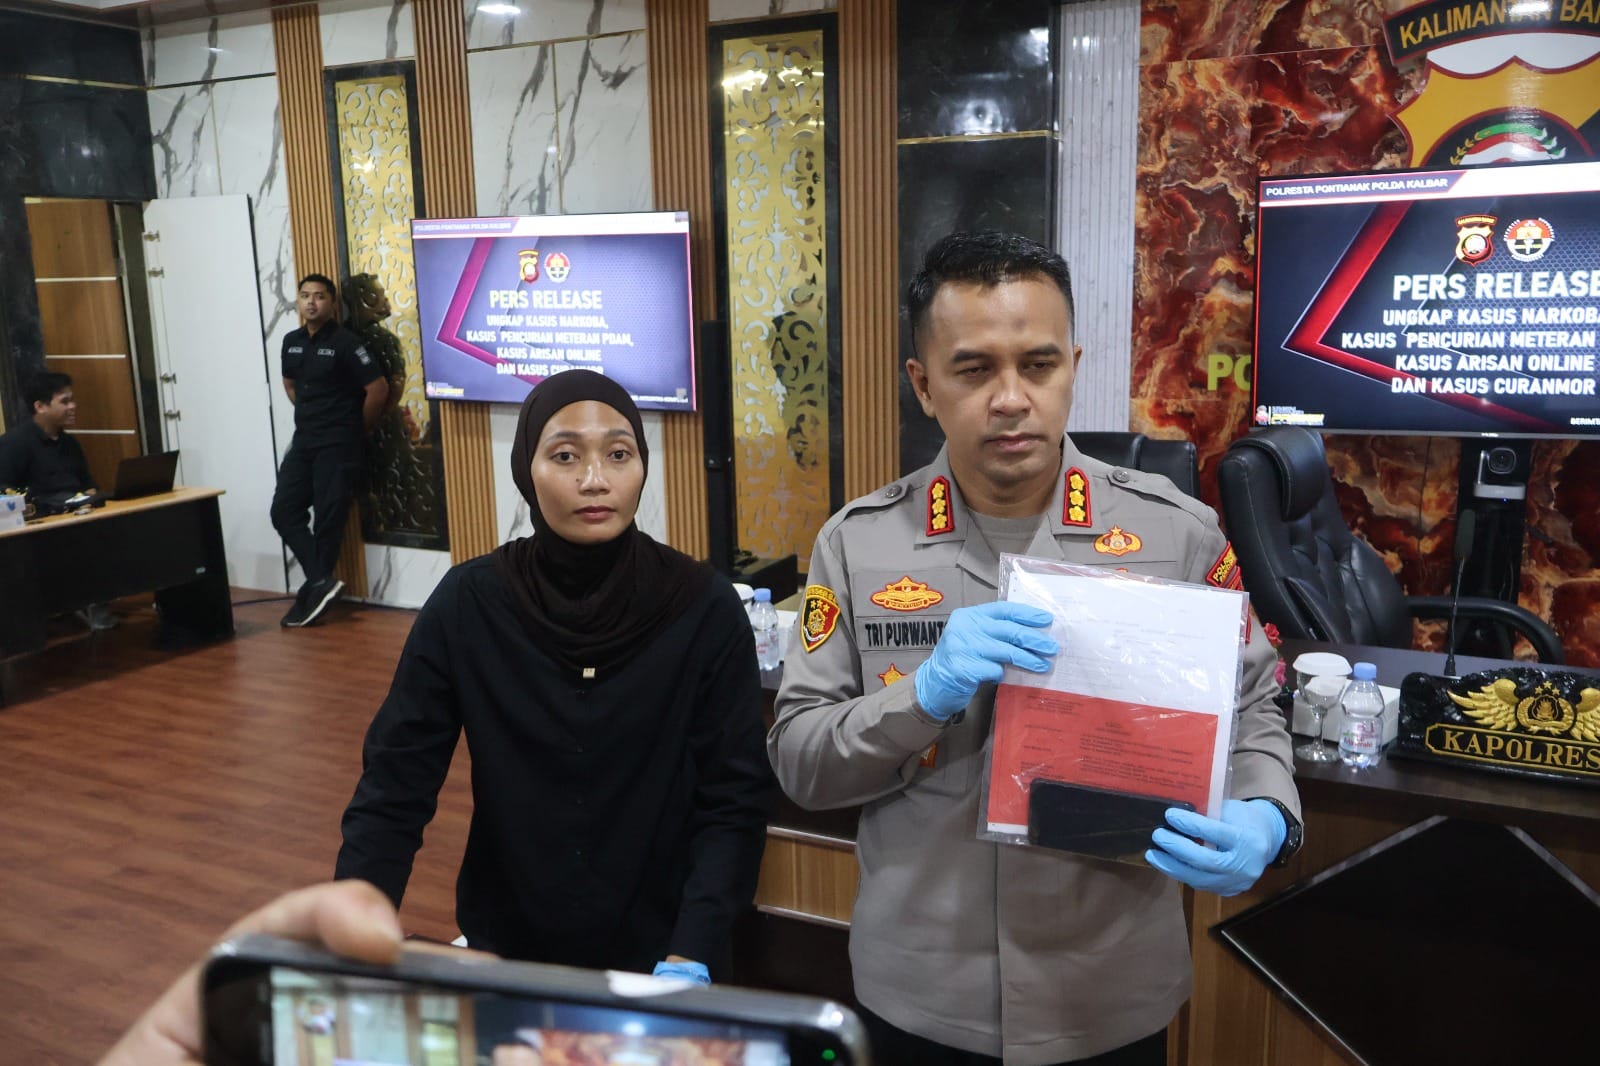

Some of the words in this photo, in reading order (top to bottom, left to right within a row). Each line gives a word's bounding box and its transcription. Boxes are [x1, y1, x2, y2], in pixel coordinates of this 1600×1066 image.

[1400, 0, 1552, 48] KALIMAN
[1266, 185, 1314, 196] POLRESTA
[1315, 182, 1370, 194] PONTIANAK
[1371, 180, 1405, 191] POLDA
[1406, 178, 1448, 189] KALBAR
[1393, 273, 1466, 300] PERS
[489, 290, 529, 309] PERS
[532, 290, 603, 309] RELEASE
[486, 315, 523, 327] UNGKAP
[525, 315, 557, 327] KASUS
[1382, 308, 1453, 326] UNGKAP
[1457, 307, 1517, 325] KASUS
[1521, 306, 1600, 324] NARKOB
[466, 330, 496, 342] KASUS
[501, 331, 553, 343] PENCURIAN
[555, 332, 600, 345] METERAN
[1341, 332, 1397, 349] KASUS
[1406, 331, 1505, 348] PENCURIAN
[1509, 331, 1596, 348] METERAN
[496, 347, 527, 359] KASUS
[529, 348, 565, 360] ARISAN
[566, 349, 602, 361] ONLINE
[1395, 354, 1453, 371] KASUS
[1456, 354, 1523, 371] ARISAN
[1527, 355, 1595, 371] ONLINE
[496, 363, 516, 375] DAN
[518, 364, 549, 376] KASUS
[1391, 377, 1427, 394] DAN
[1431, 377, 1489, 394] KASUS
[1493, 378, 1596, 395] CURANMOR
[865, 622, 883, 647] TRI
[886, 620, 949, 647] PURWANT
[1443, 730, 1600, 770] KAPOLRES
